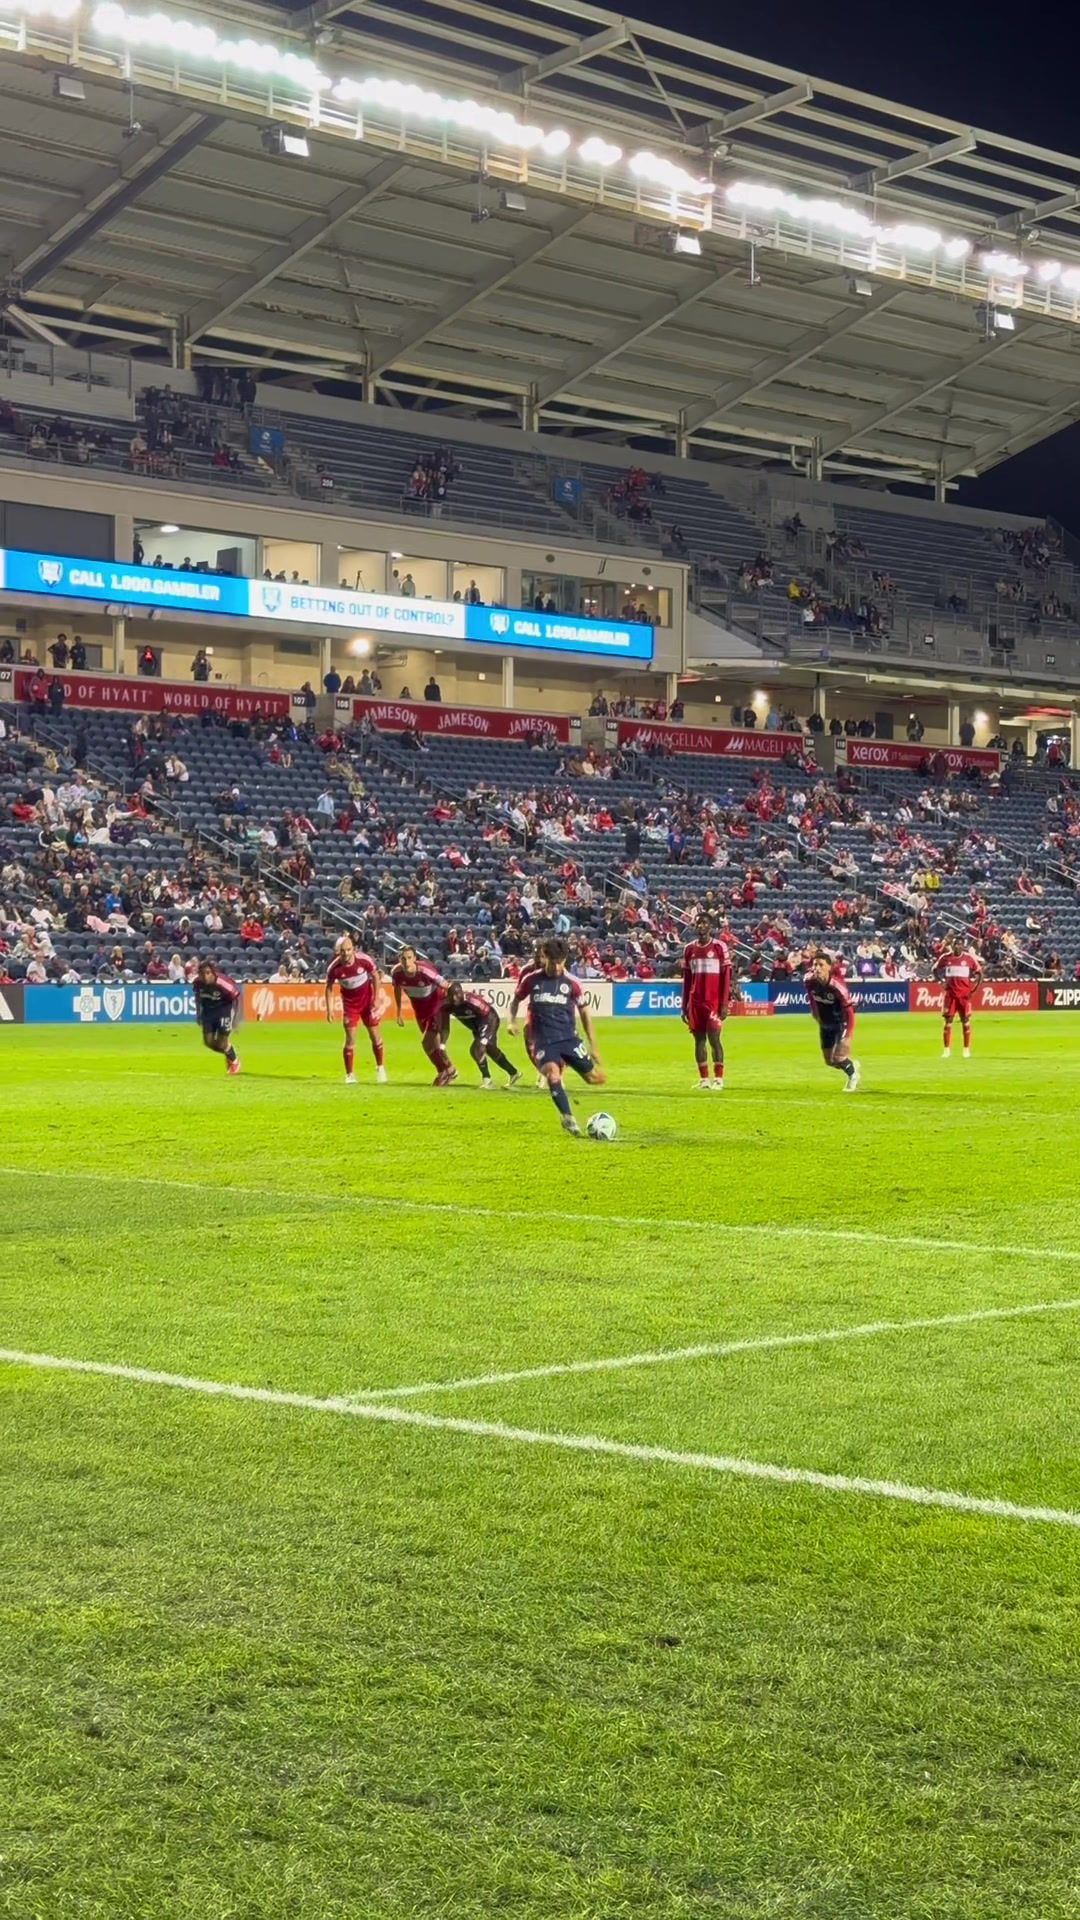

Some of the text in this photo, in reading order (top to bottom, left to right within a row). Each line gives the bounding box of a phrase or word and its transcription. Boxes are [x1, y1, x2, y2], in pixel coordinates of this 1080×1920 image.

[69, 568, 105, 588] CALL
[290, 596, 455, 625] BETTING OUT OF CONTROL?
[514, 620, 541, 637] CALL
[0, 671, 11, 680] 07
[78, 685, 97, 699] OF
[101, 687, 148, 703] HYATT
[164, 692, 280, 713] WORLD OF HYATT
[293, 696, 306, 705] 107
[365, 706, 417, 726] JAMESON
[437, 713, 490, 733] JAMESON
[508, 718, 558, 735] JAMESON
[651, 731, 713, 748] MAGELLAN
[743, 740, 799, 754] MAGELLAN
[852, 746, 889, 763] xerox
[929, 752, 964, 767] xrox
[132, 990, 197, 1016] Illinois
[982, 987, 1031, 1007] Portillo's
[574, 1043, 590, 1059] 10
